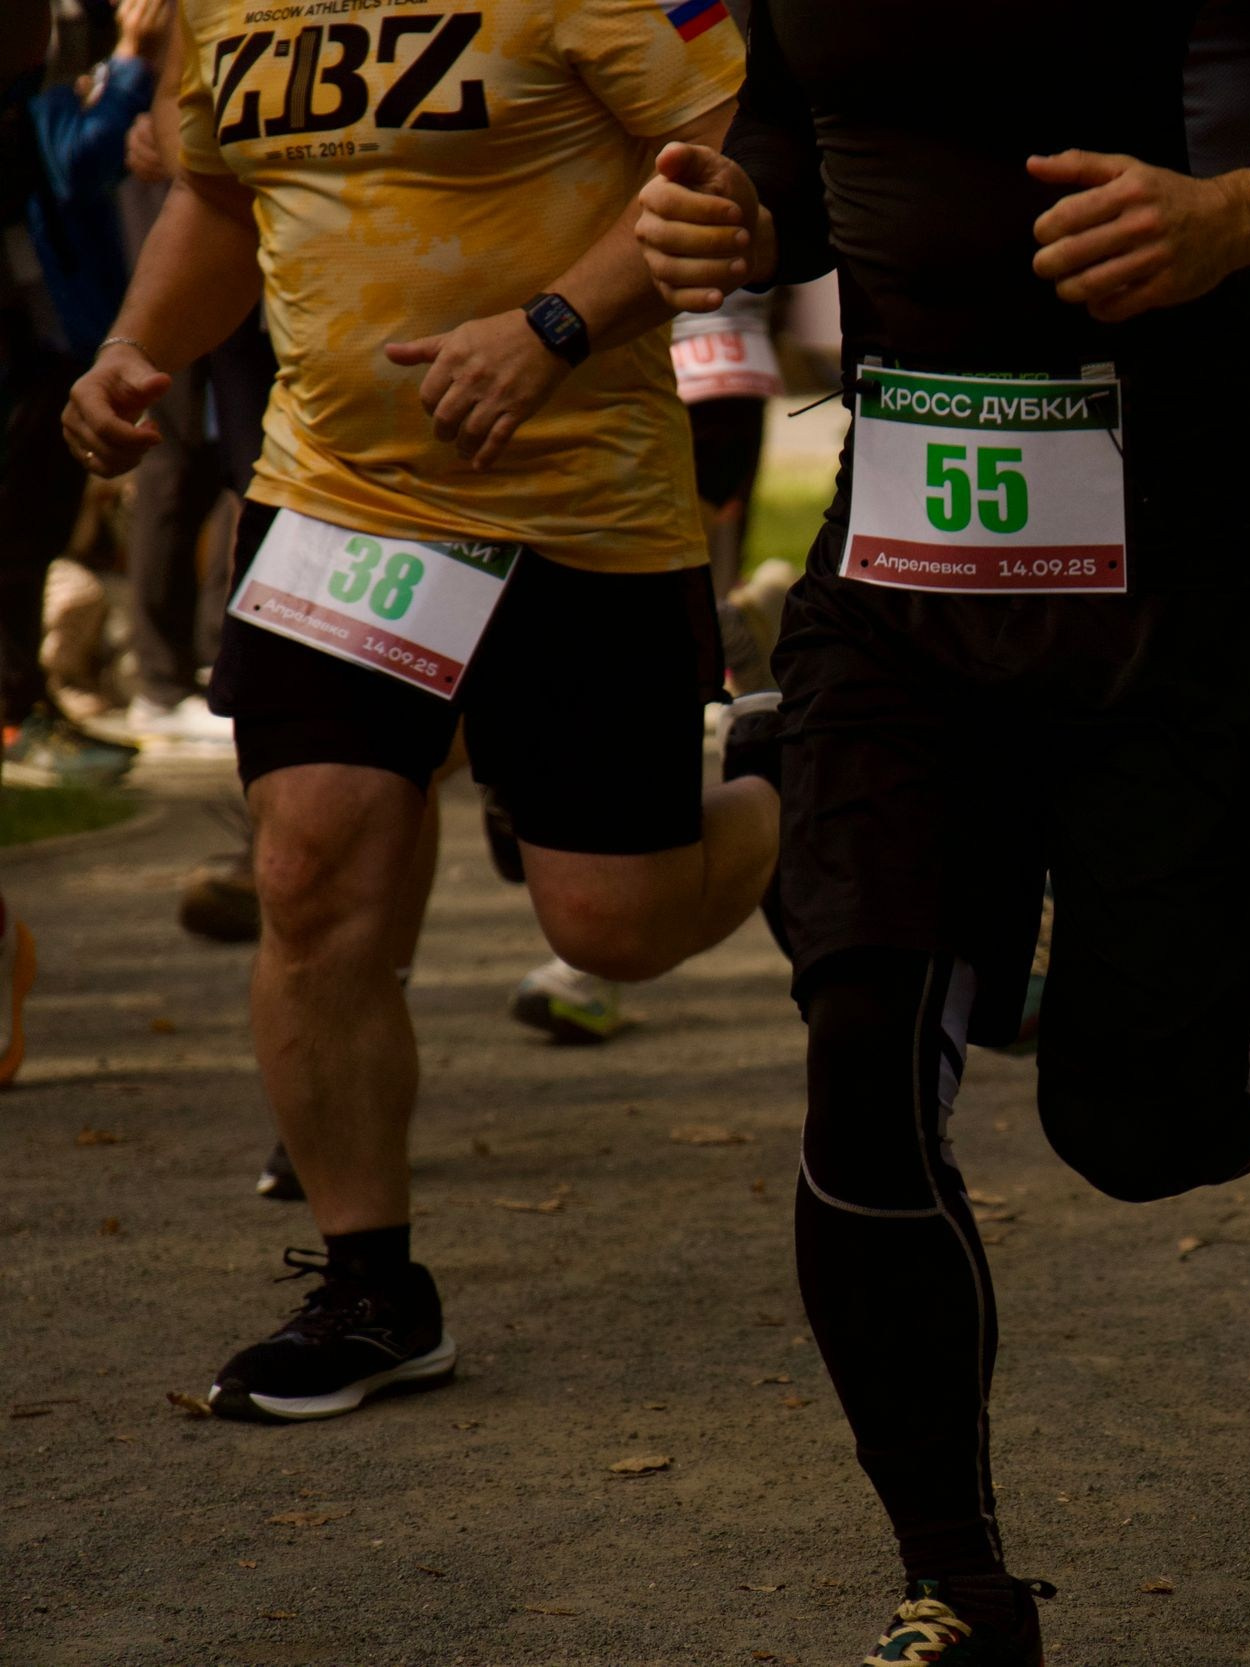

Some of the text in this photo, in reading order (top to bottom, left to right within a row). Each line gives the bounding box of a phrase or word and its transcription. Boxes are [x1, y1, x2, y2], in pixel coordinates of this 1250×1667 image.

[244, 0, 381, 24] MOSCOW ATHLETICS
[212, 12, 489, 146] ZBZ
[285, 140, 355, 161] EST. 2019
[880, 385, 1089, 425] КРОСС ДУБКИ
[926, 442, 1029, 534] 55
[327, 535, 425, 621] 38
[873, 551, 1097, 578] Апрелевка 14.09.25
[361, 635, 439, 678] 14.09.25
